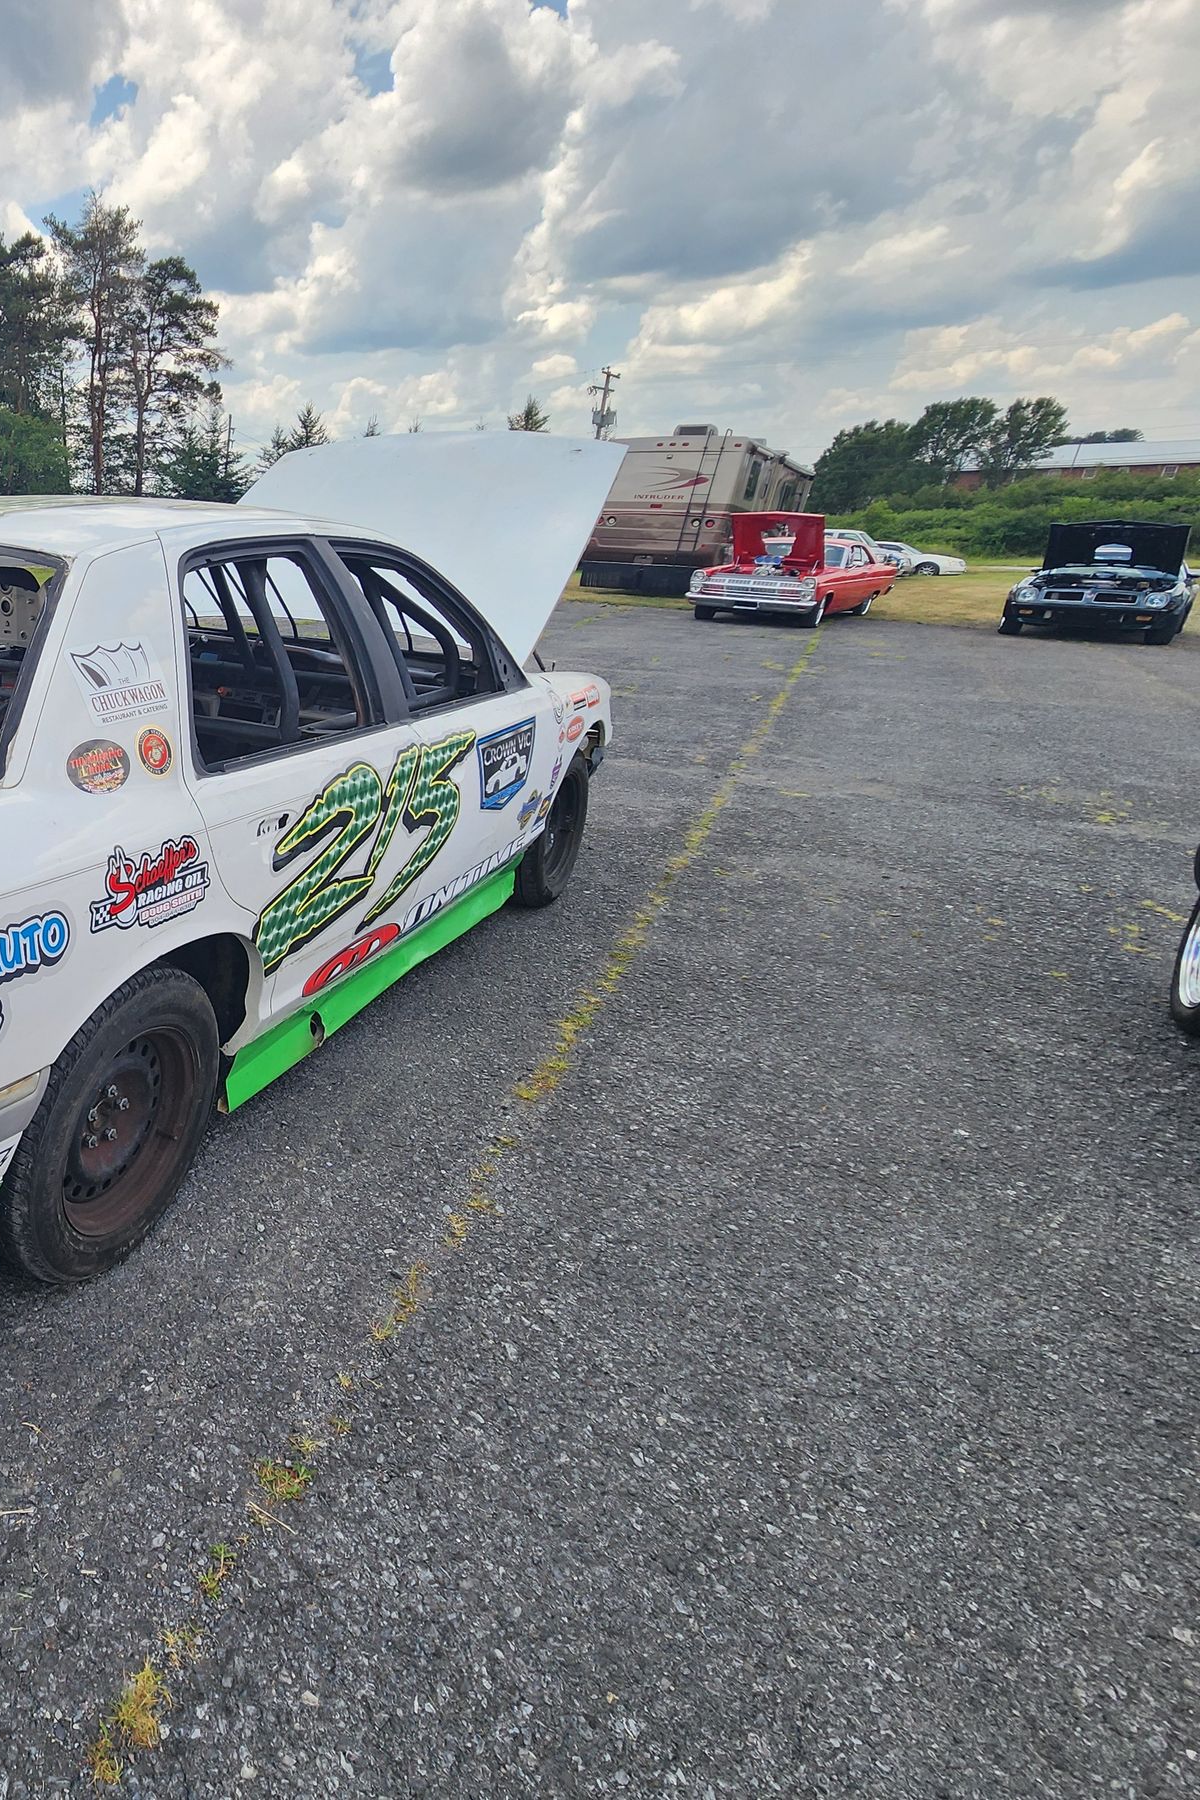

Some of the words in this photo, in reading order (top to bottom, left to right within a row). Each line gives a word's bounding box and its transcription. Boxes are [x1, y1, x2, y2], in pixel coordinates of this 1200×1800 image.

[117, 676, 130, 684] THE
[101, 711, 136, 724] RESTAURANT
[143, 703, 168, 715] CATERING
[484, 738, 516, 766] CROWN
[518, 731, 531, 751] VIC
[256, 731, 477, 977] 215
[137, 878, 183, 908] RACING
[185, 871, 204, 890] OIL
[141, 901, 171, 921] DOUG
[171, 888, 202, 909] SMITH
